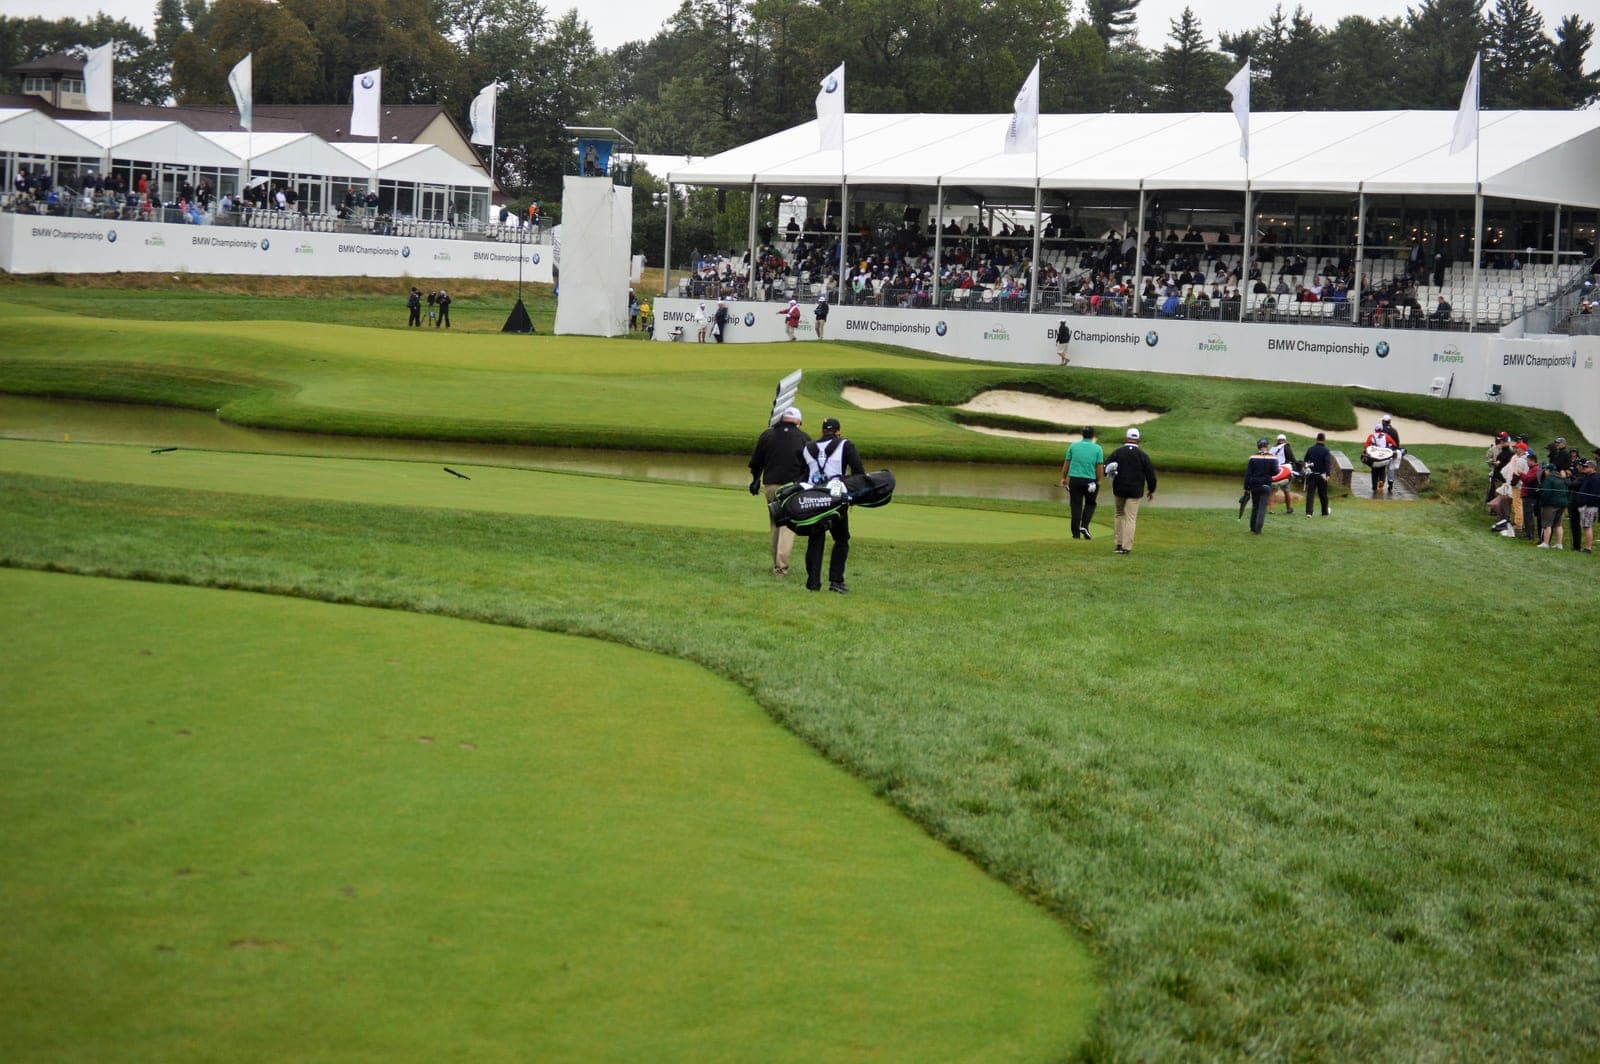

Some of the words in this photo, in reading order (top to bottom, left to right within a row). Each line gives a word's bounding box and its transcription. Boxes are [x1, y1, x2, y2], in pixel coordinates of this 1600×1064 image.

[32, 228, 51, 237] BMW
[53, 229, 103, 241] Championship
[192, 236, 210, 245] BMW
[211, 238, 258, 248] Championship
[338, 244, 355, 253] BMW
[356, 245, 399, 256] Championship
[473, 252, 489, 260] BMW
[663, 311, 684, 321] BMW
[846, 320, 869, 331] BMW
[870, 321, 931, 335] Championship
[1073, 330, 1140, 348] Championship
[1268, 339, 1295, 351] BMW
[1296, 340, 1370, 356] Championship
[1503, 354, 1525, 366] BMW
